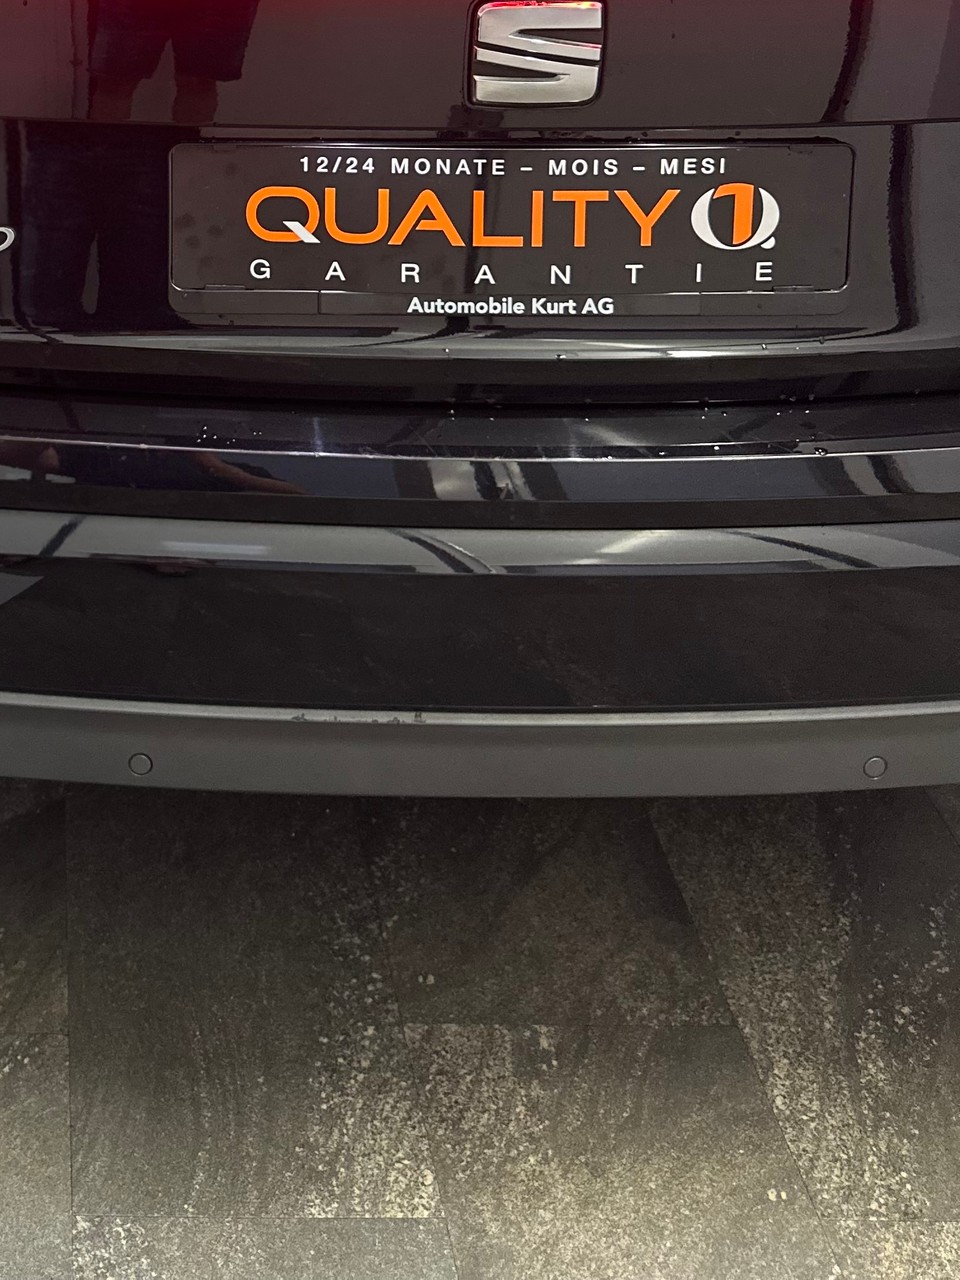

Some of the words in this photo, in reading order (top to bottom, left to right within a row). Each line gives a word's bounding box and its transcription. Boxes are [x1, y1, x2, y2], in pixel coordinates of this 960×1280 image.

[299, 156, 375, 174] 12/24
[390, 157, 506, 176] MONATE
[548, 158, 619, 176] MOIS
[660, 157, 726, 175] MESI
[245, 185, 681, 248] QUALITY
[249, 258, 773, 285] GARANTIE
[406, 296, 526, 315] Automobile
[531, 297, 577, 315] Kurt
[581, 297, 615, 315] AG
